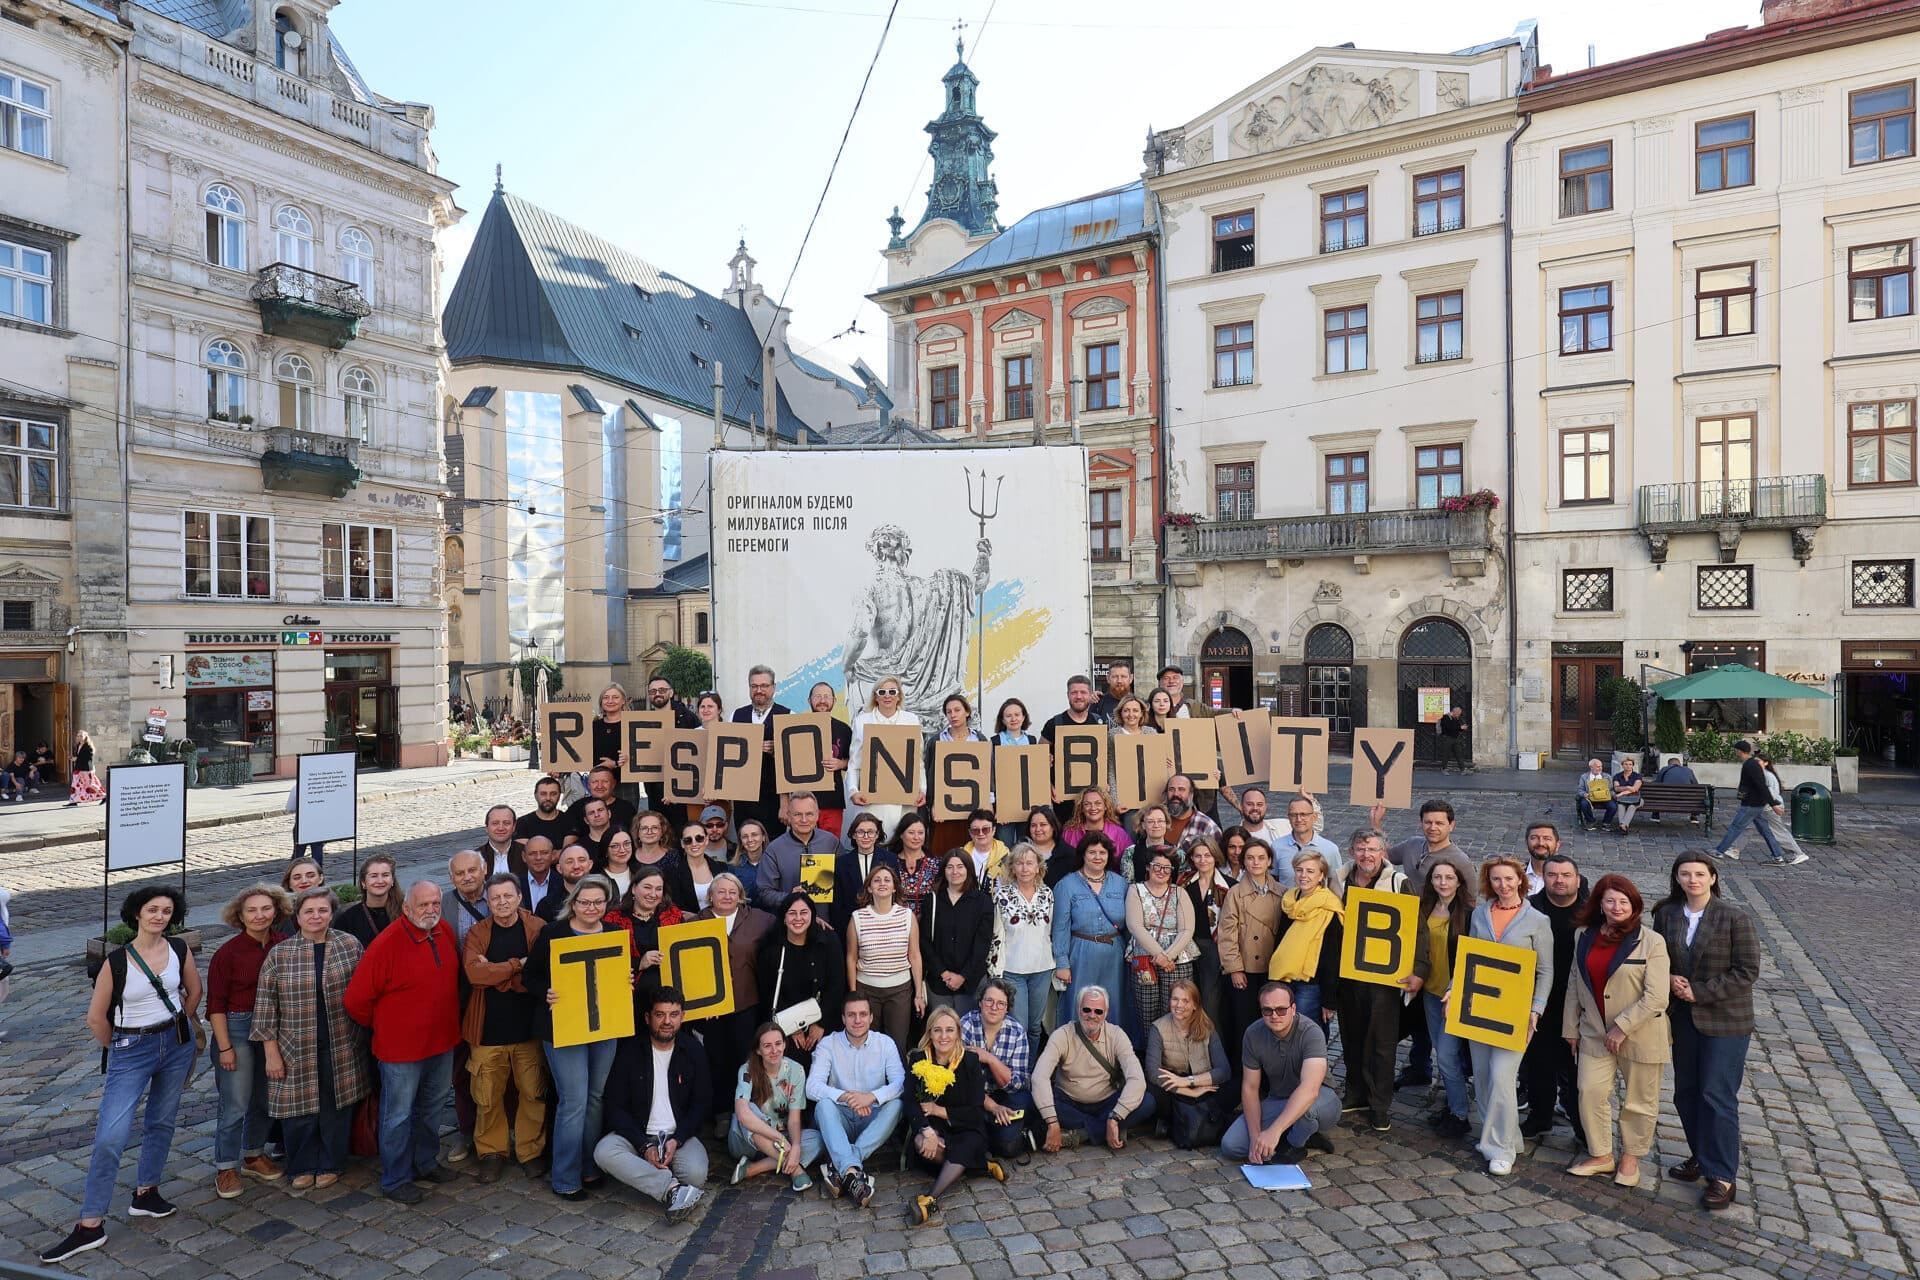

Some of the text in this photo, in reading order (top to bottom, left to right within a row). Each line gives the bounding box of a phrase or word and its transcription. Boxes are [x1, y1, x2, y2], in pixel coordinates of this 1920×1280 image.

[727, 495, 853, 511] ОРИГІНАЛОМ БУДЕМО
[727, 516, 847, 530] МИЛУВАТИСЯ ПІСЛЯ
[728, 538, 789, 552] ПЕРЕМОГИ
[188, 634, 278, 643] RISTORANTE
[332, 634, 391, 643] РЕСТОРАН
[1207, 644, 1249, 656] МУЗЕЙ
[559, 901, 1521, 1035] TO BE
